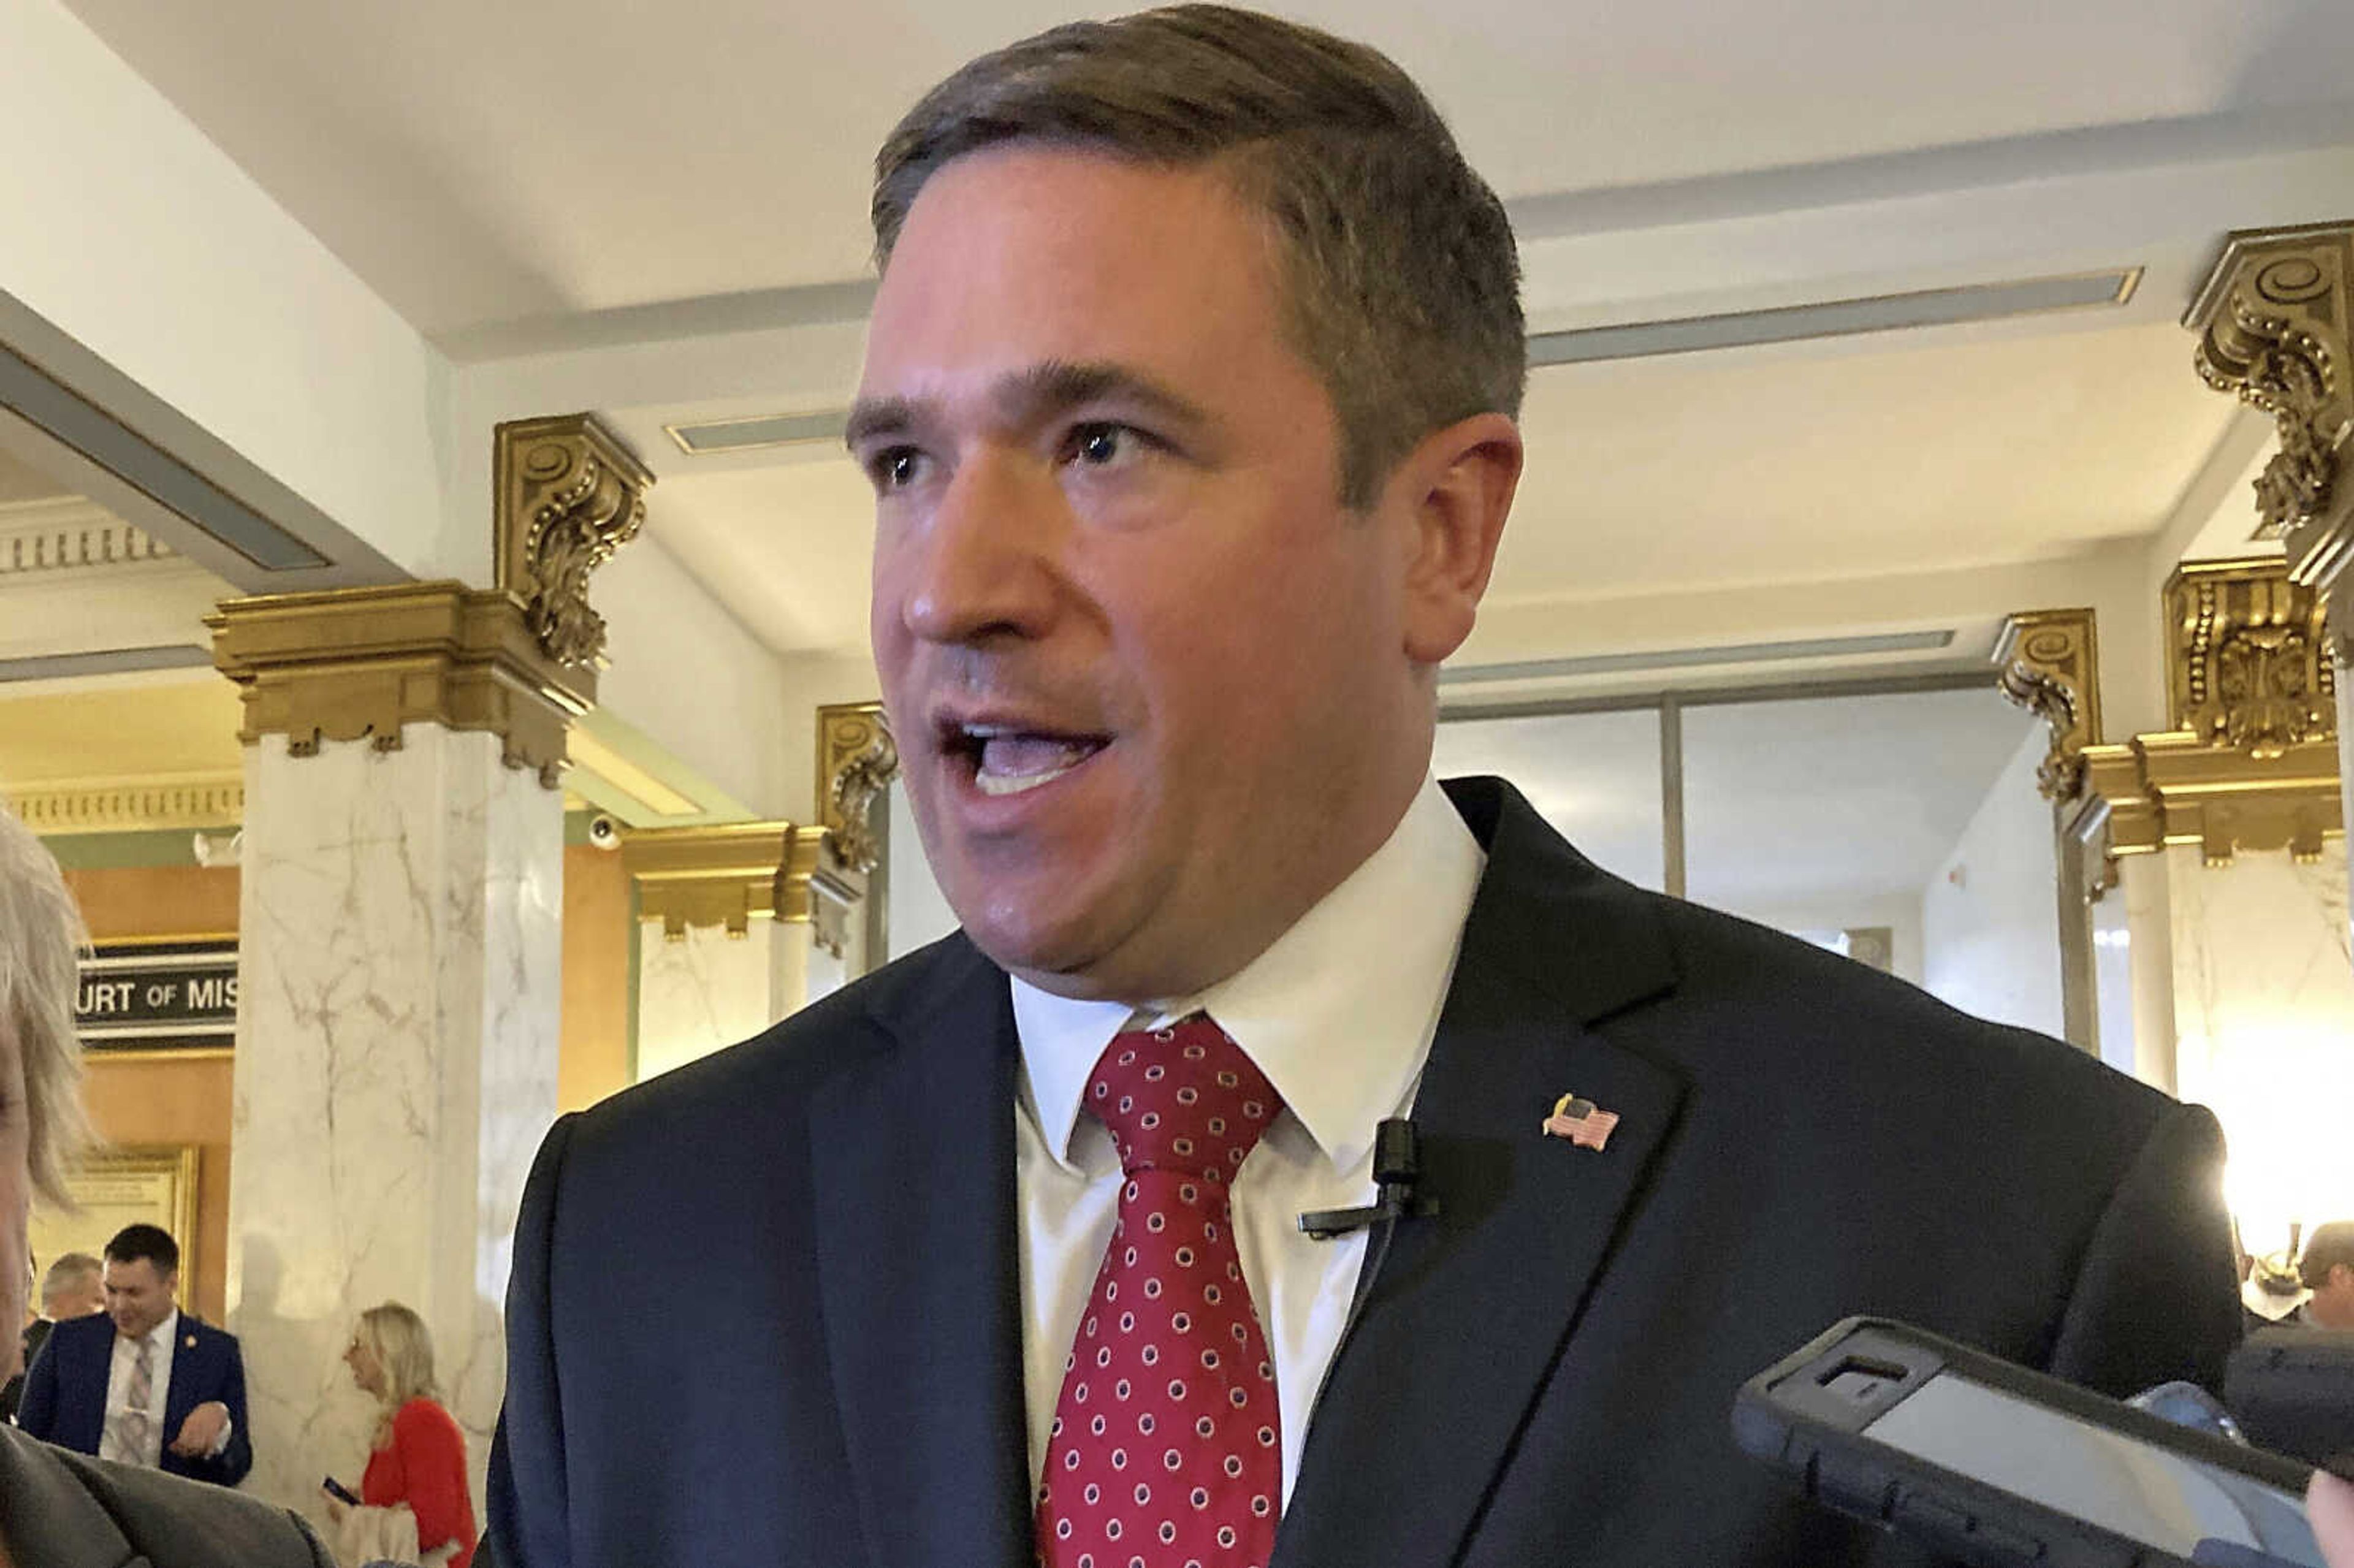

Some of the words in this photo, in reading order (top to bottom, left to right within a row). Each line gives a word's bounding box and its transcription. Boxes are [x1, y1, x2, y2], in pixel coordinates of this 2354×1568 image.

[75, 983, 135, 1014] URT
[147, 984, 177, 1007] OF
[188, 978, 237, 1009] MIS
